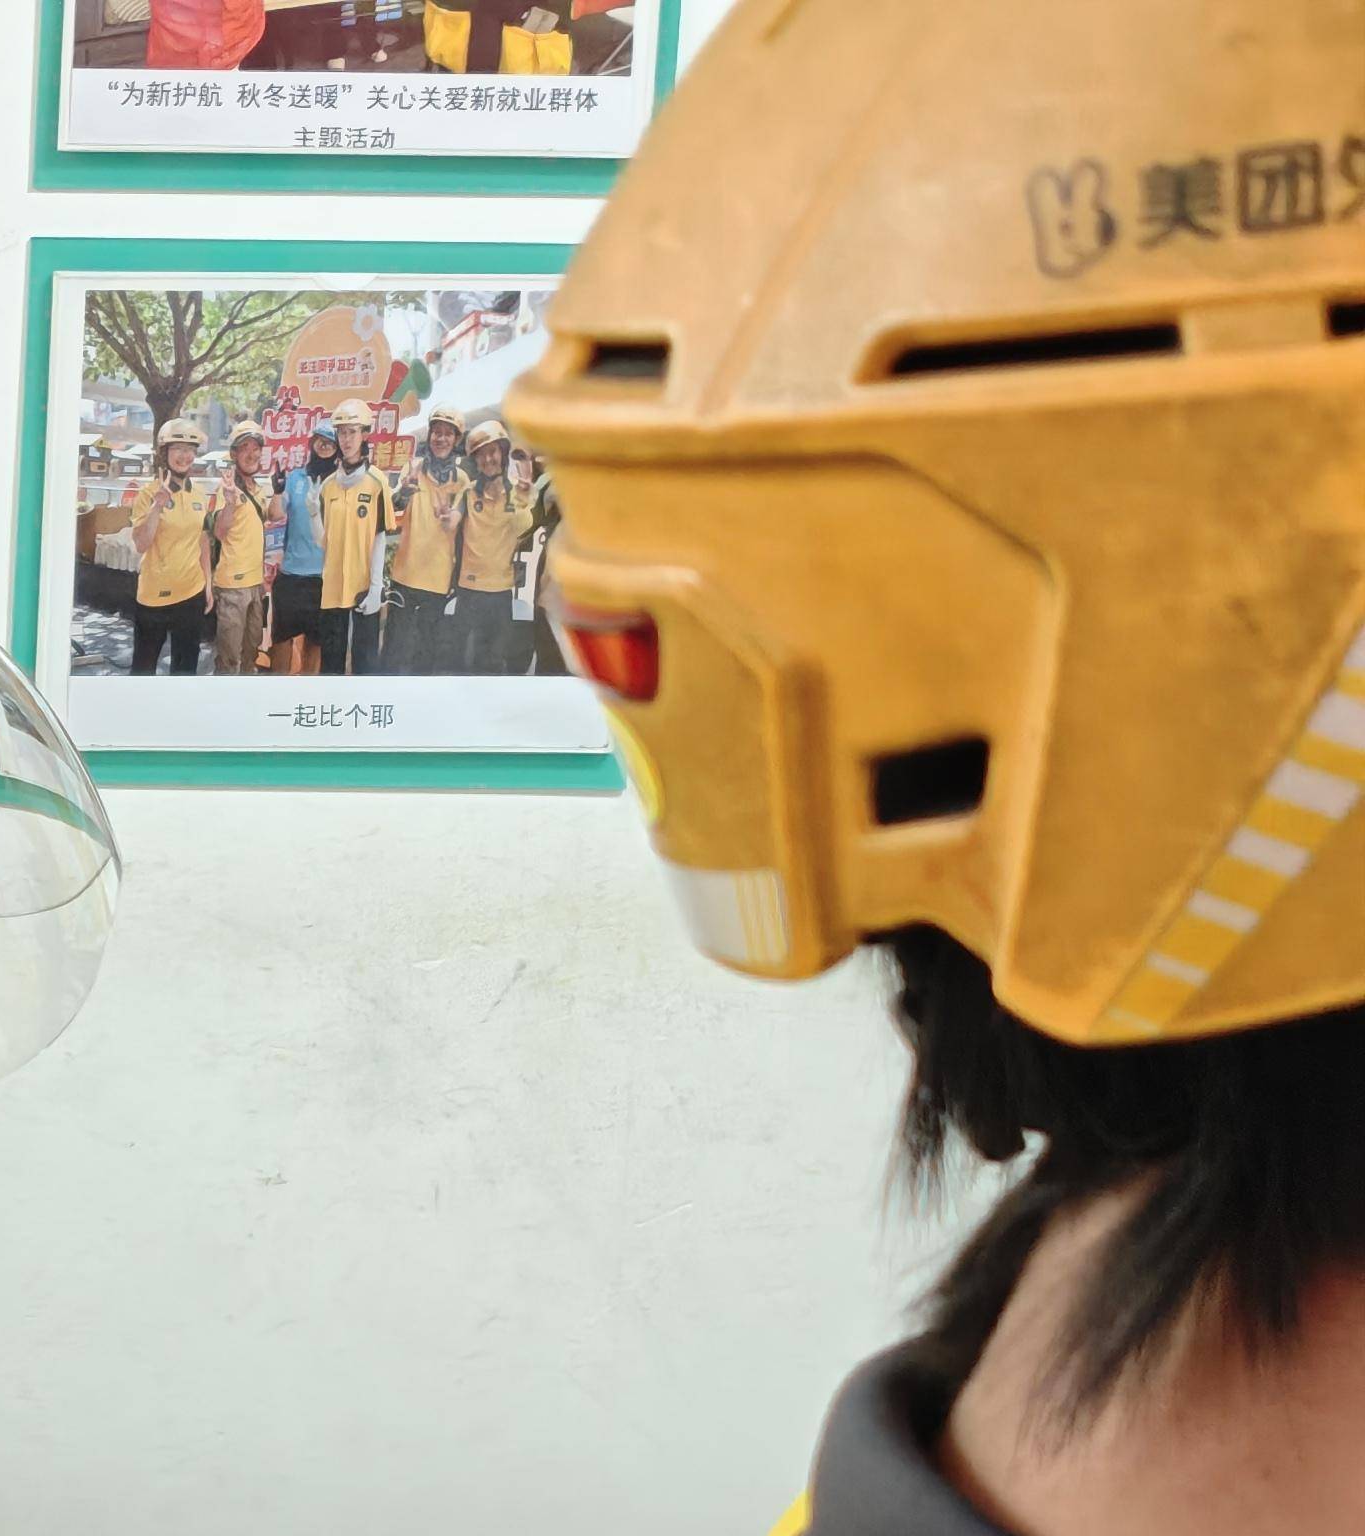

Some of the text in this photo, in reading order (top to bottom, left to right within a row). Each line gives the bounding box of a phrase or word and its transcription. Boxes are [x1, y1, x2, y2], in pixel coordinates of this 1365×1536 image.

[293, 126, 396, 149] 主题活动
[267, 703, 394, 729] 一起比个耶
